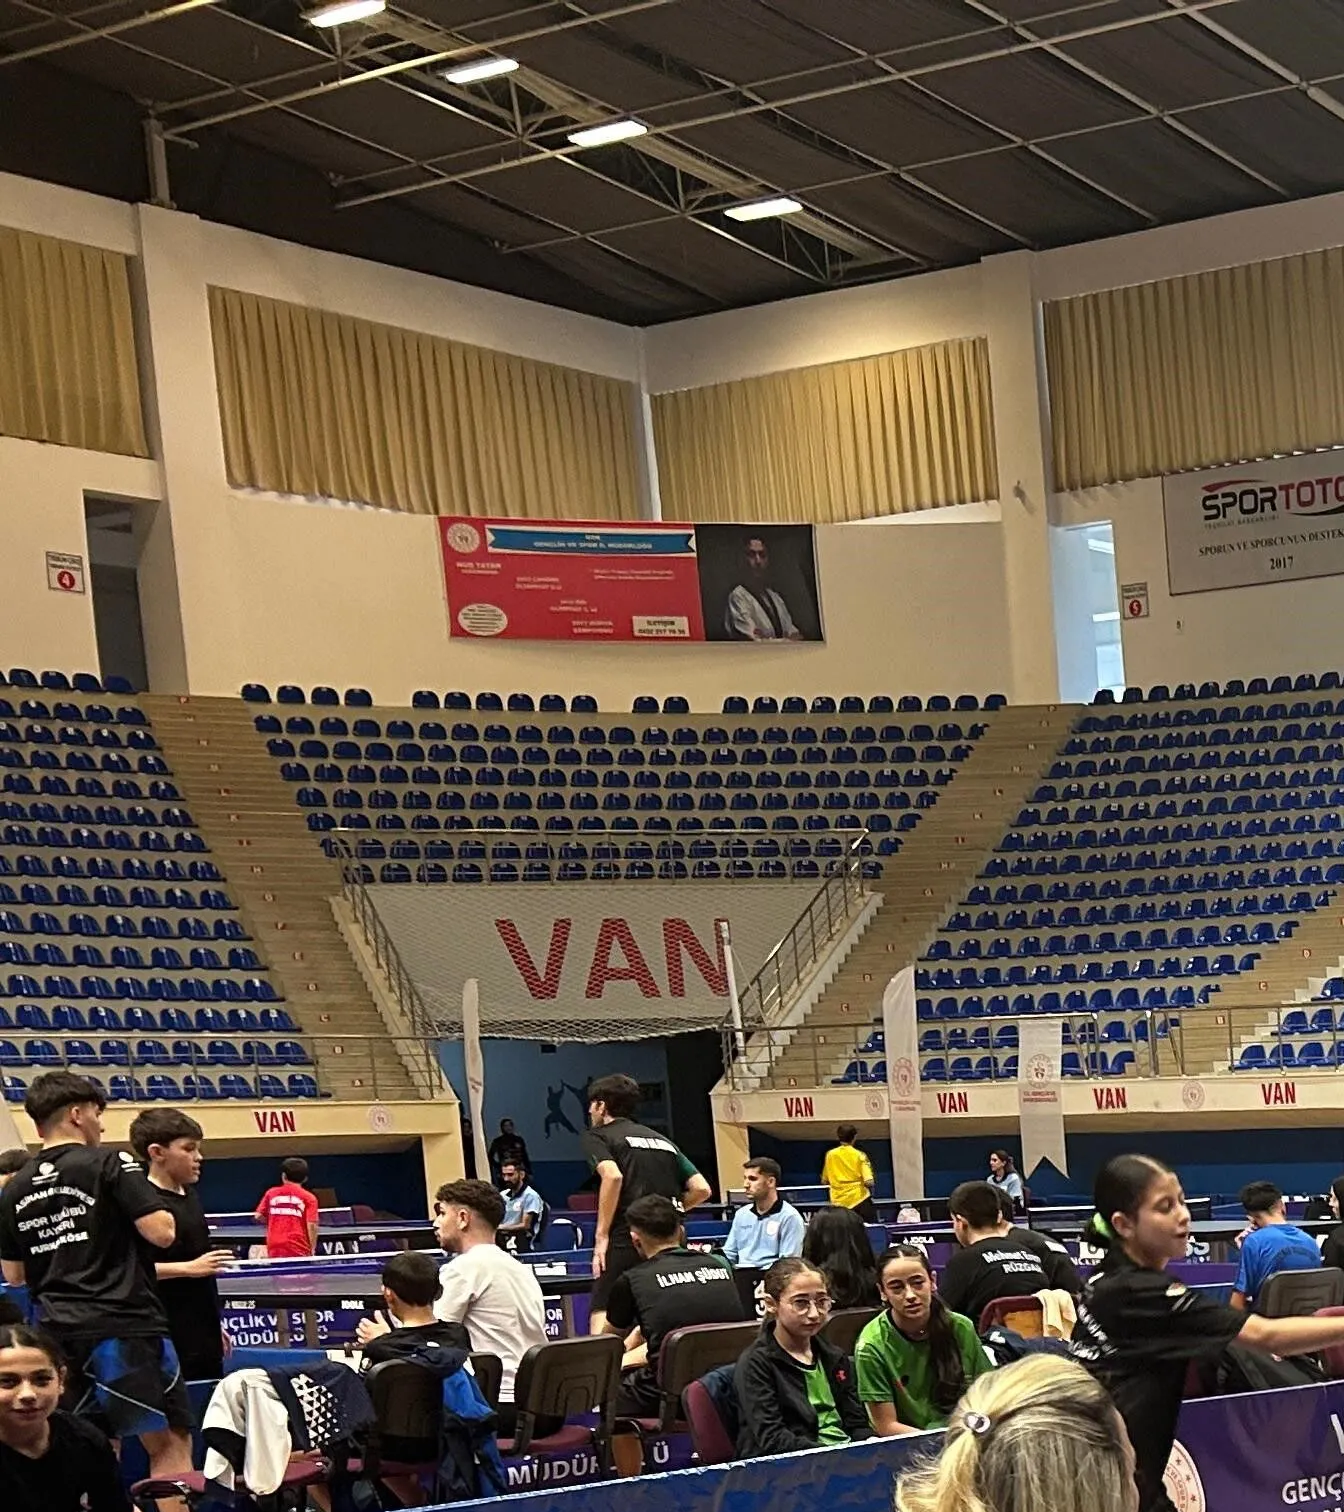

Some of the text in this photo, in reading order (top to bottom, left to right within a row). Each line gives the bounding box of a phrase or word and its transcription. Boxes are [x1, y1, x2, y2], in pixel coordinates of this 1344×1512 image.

[1198, 544, 1235, 557] SPORUN
[1269, 556, 1294, 570] 2017
[494, 918, 733, 1000] VAN
[937, 1091, 969, 1114] VAN
[1093, 1087, 1126, 1110] VAN
[1260, 1082, 1296, 1106] VAN
[784, 1097, 815, 1118] VAN
[254, 1110, 295, 1132] VAN
